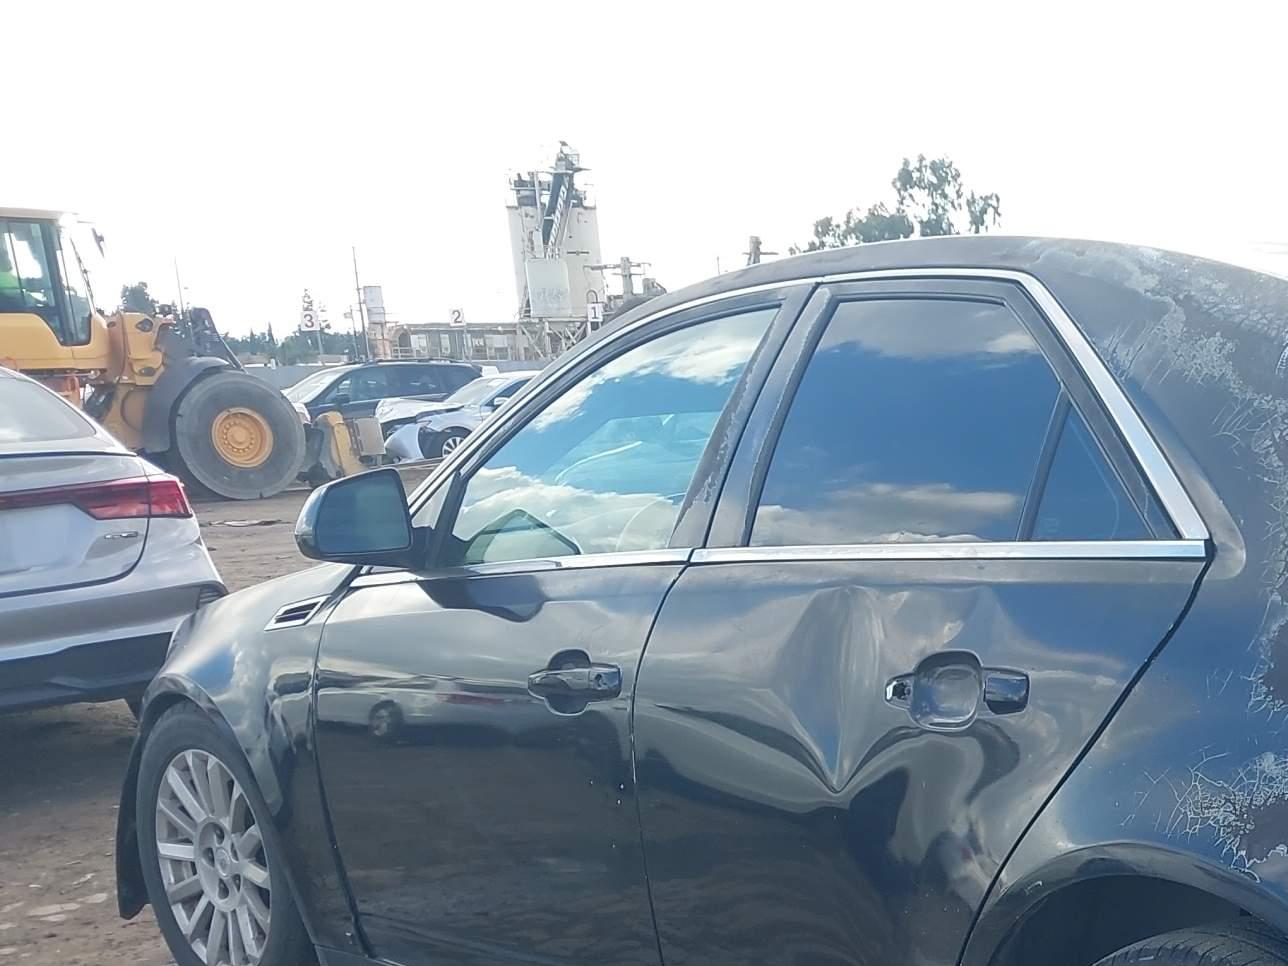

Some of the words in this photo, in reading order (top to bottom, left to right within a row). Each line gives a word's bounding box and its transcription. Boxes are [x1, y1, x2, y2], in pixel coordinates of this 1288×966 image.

[303, 313, 315, 328] 3
[452, 309, 463, 324] 2
[591, 306, 599, 320] 1
